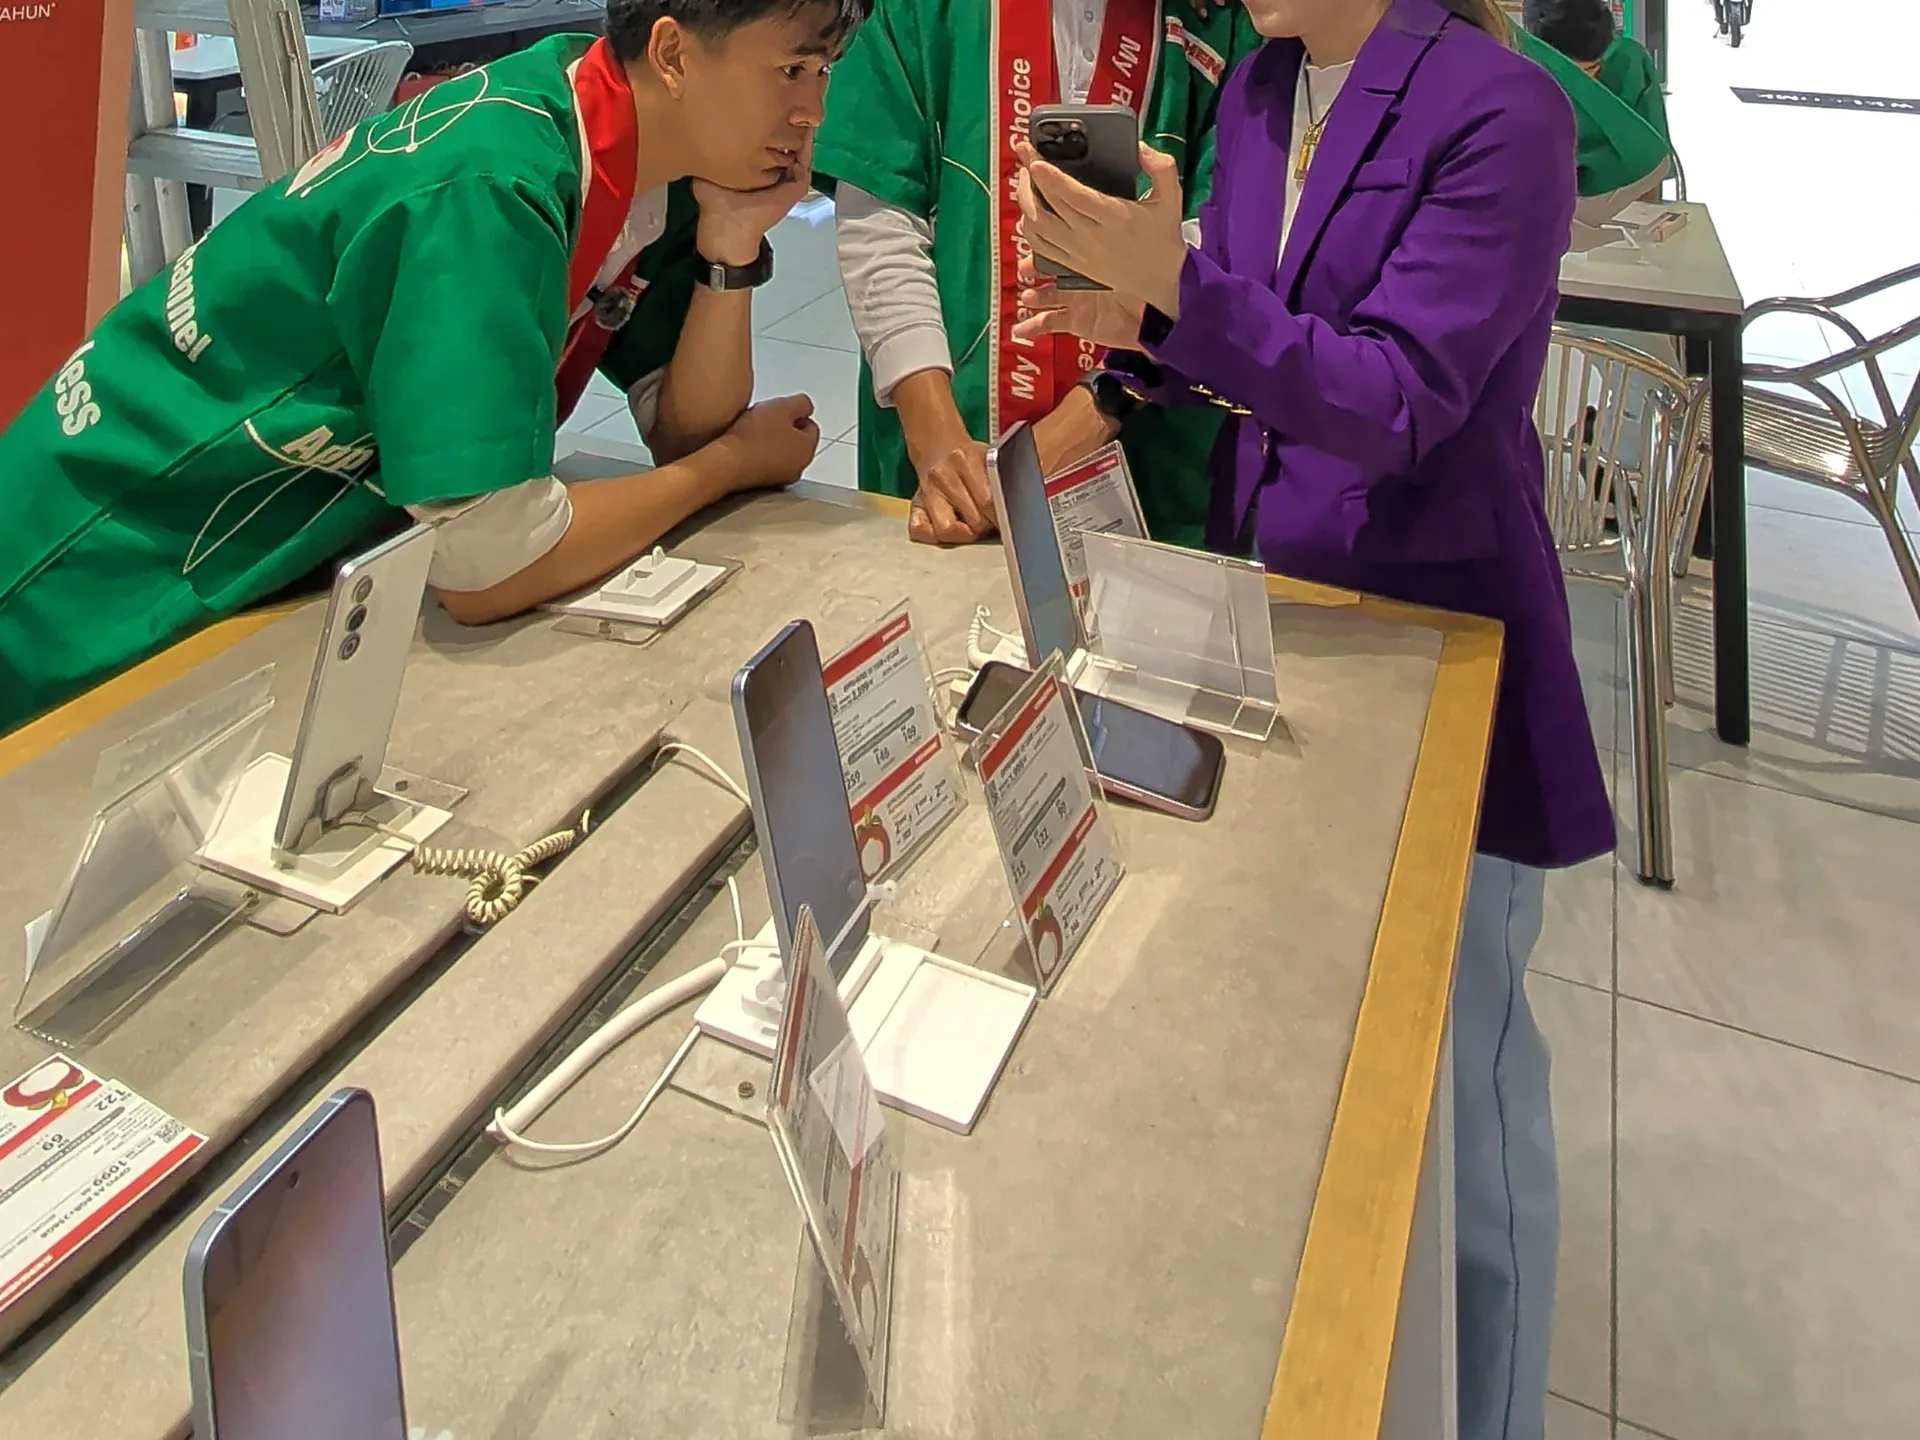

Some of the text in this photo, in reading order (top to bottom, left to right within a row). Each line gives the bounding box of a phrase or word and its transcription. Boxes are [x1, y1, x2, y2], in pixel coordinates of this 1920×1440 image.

[0, 3, 56, 21] AHUN
[1111, 35, 1141, 79] My
[1011, 356, 1042, 400] My
[95, 1088, 127, 1111] 122
[42, 1133, 64, 1151] 69
[92, 1158, 128, 1187] 1099
[106, 1167, 132, 1187] OPPO
